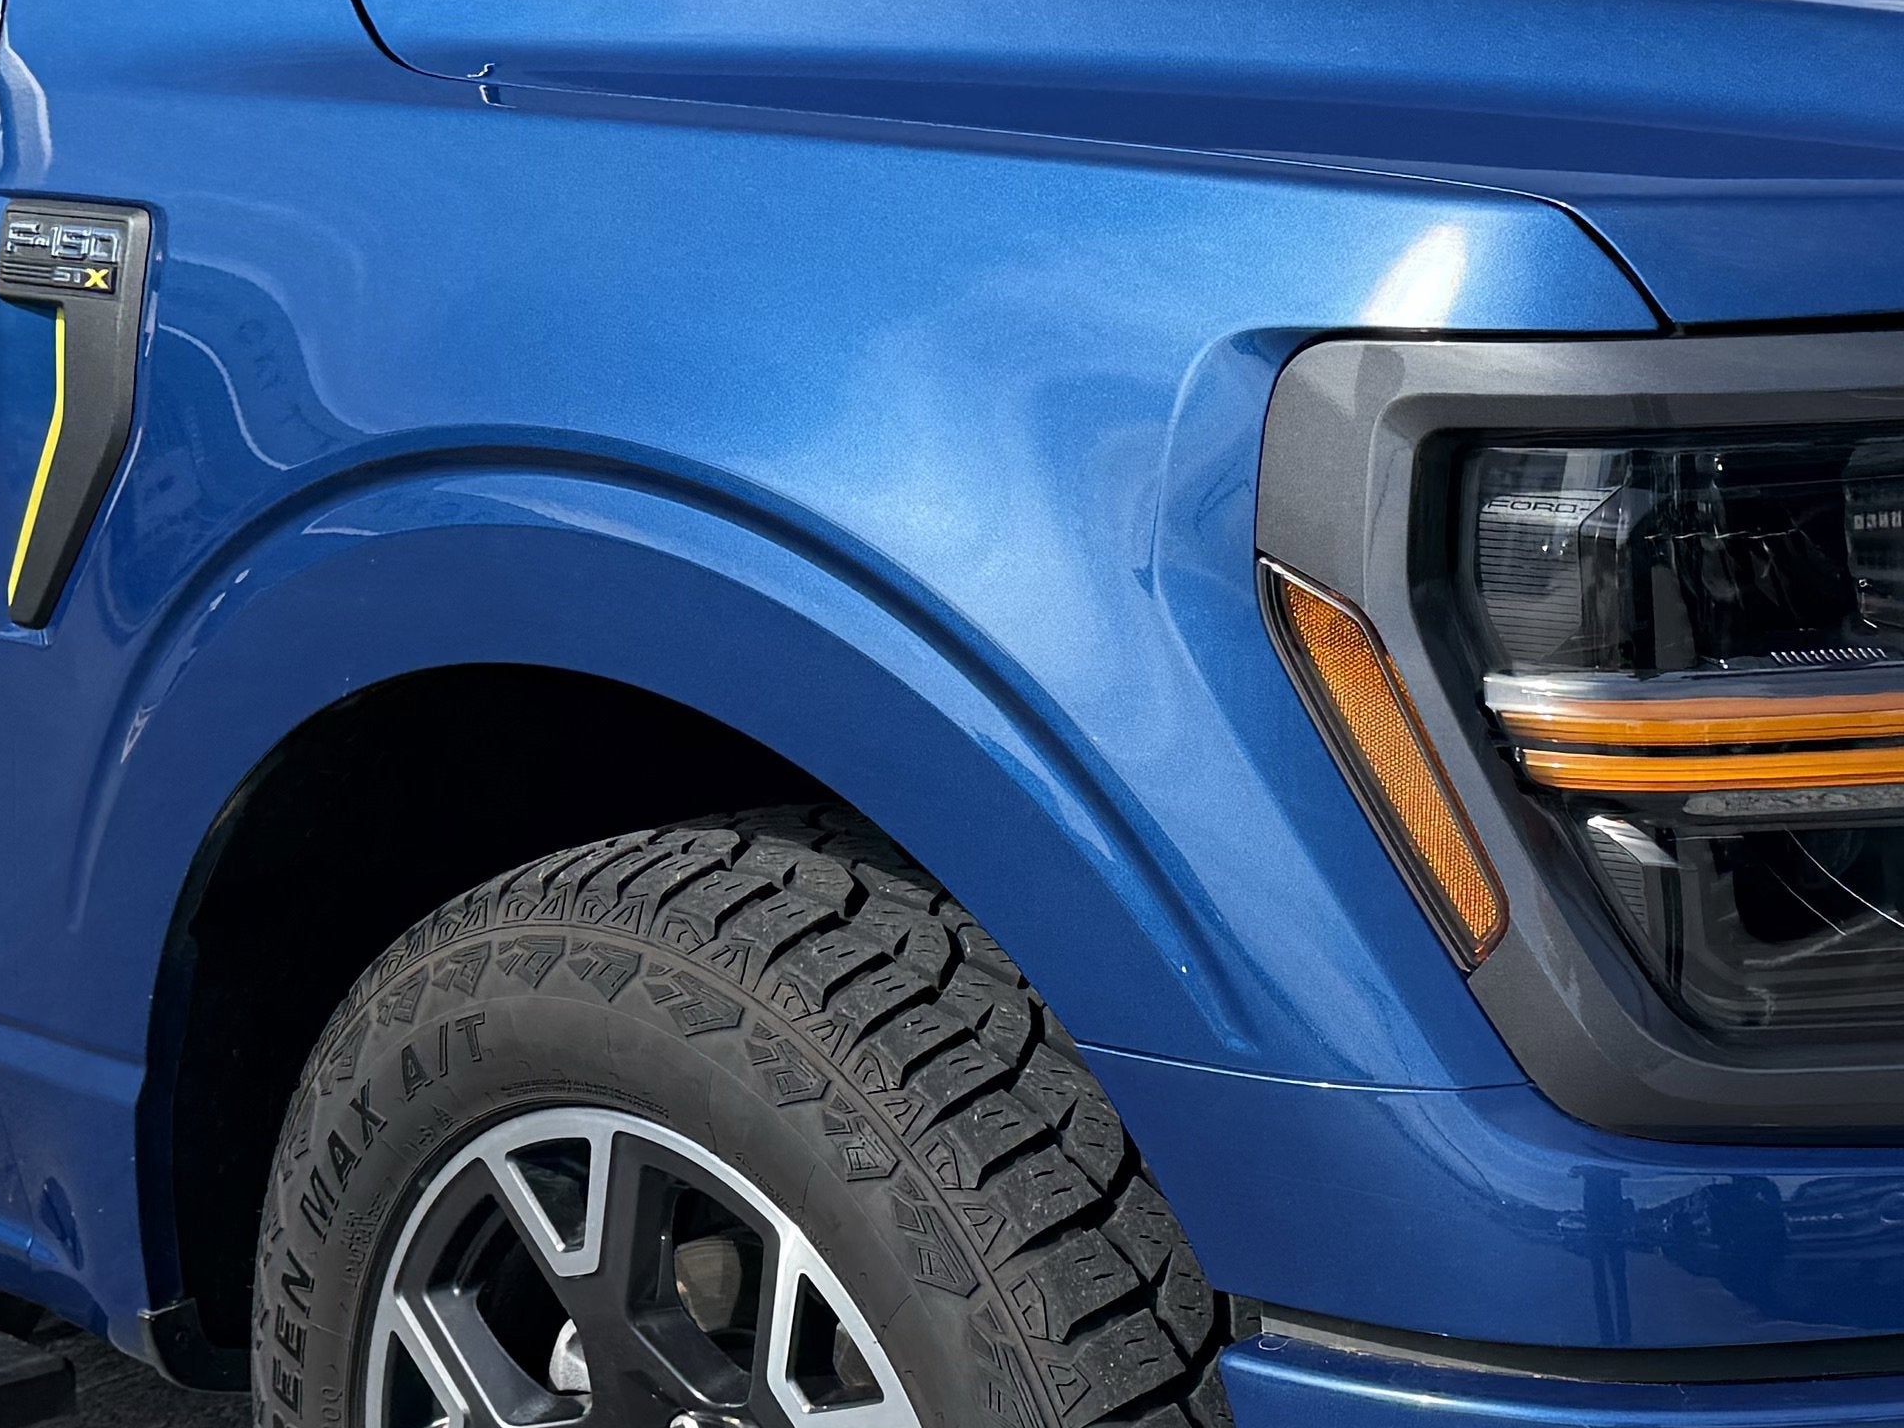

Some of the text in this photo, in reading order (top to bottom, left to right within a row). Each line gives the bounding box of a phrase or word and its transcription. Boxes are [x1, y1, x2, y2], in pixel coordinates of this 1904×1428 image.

[5, 220, 121, 263] F-150
[52, 266, 110, 290] STX
[1487, 499, 1577, 514] FORD
[300, 1079, 388, 1244] MAX
[400, 1011, 486, 1102] A/T
